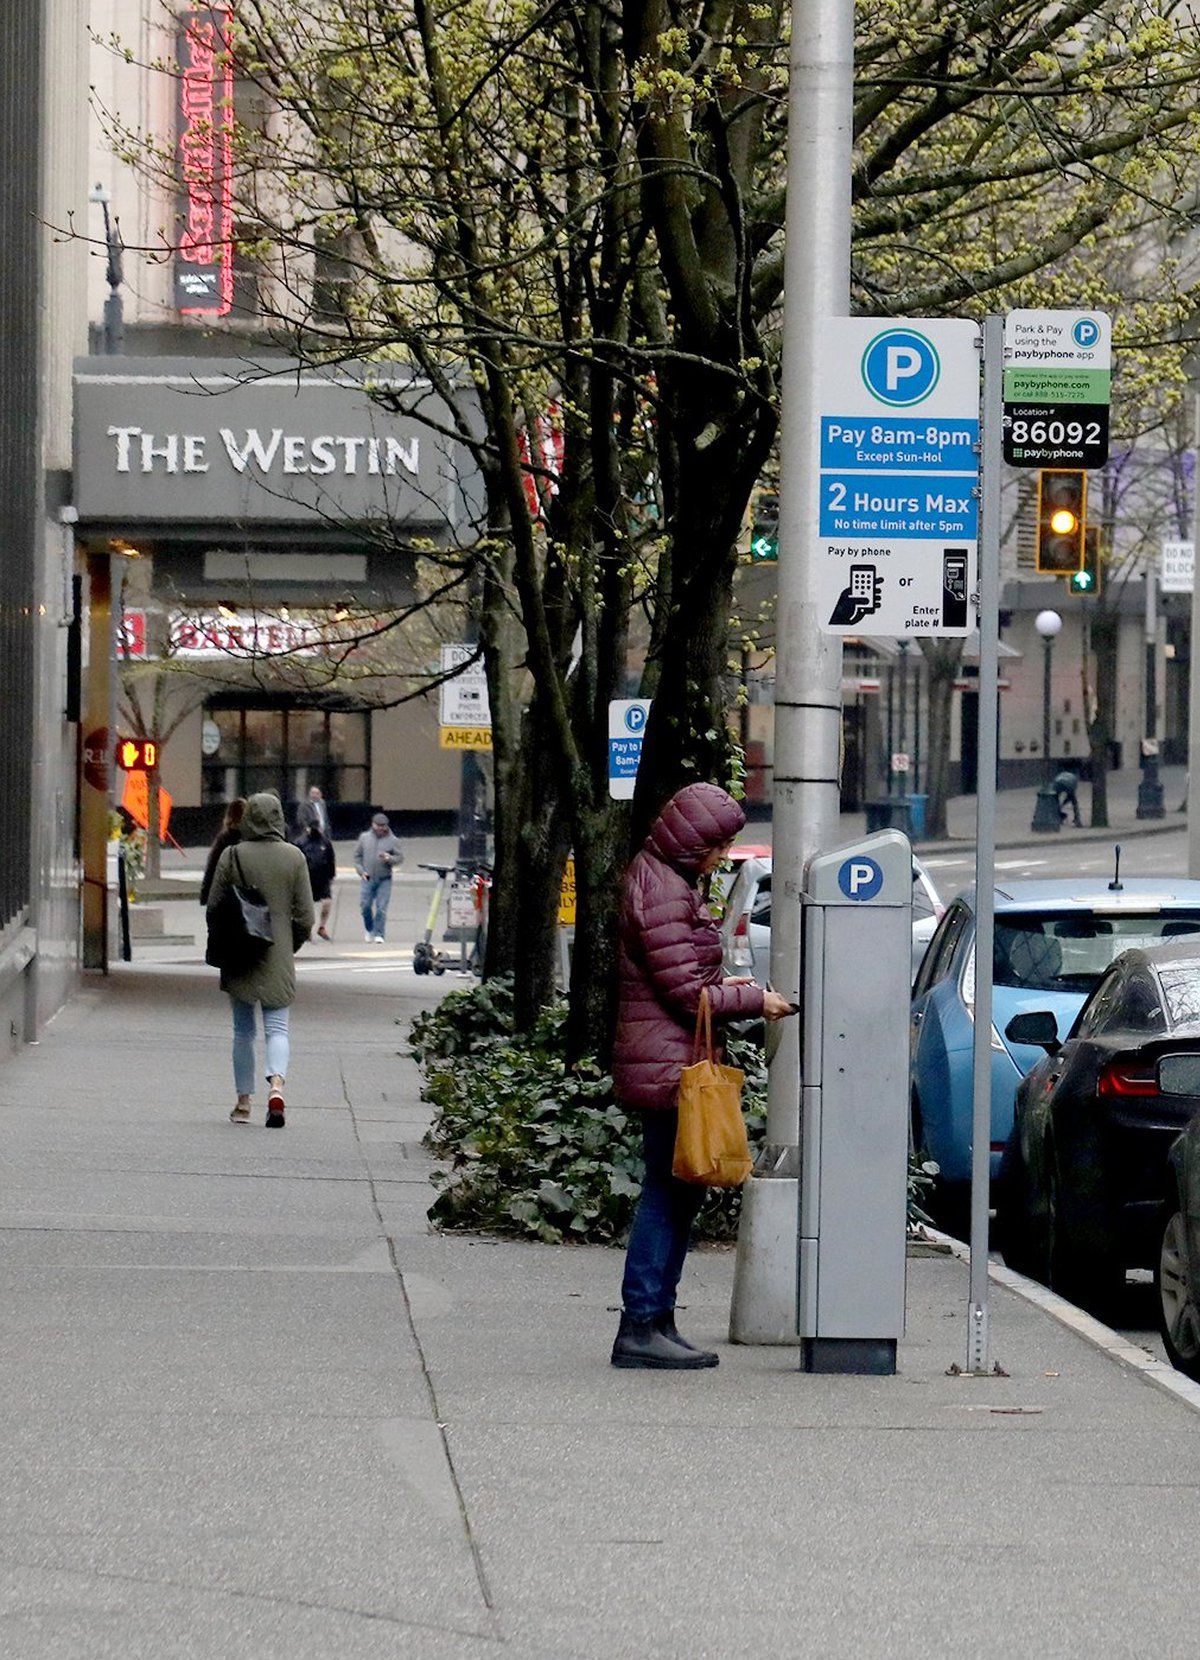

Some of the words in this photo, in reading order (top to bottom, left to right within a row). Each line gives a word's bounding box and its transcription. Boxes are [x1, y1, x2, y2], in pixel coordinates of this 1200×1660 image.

[1015, 324, 1035, 333] Park
[1037, 325, 1044, 333] &
[1046, 325, 1063, 336] Pay
[1080, 324, 1094, 341] P
[1015, 338, 1039, 347] using
[1042, 338, 1057, 346] the
[1015, 349, 1074, 360] paybyphone
[1076, 352, 1094, 360] app
[887, 346, 922, 390] P
[1014, 380, 1090, 389] paybyphone.com
[1013, 408, 1048, 416] Location
[828, 425, 865, 447] Pay
[871, 426, 971, 449] 8am-8pm
[1012, 421, 1100, 444] 86092
[107, 425, 209, 473] THE
[219, 427, 419, 475] WESTIN
[1024, 448, 1083, 458] paybyphone
[857, 451, 893, 463] Except
[896, 452, 942, 462] Sun-Hol
[828, 482, 847, 511] 2
[854, 493, 919, 512] Hours
[926, 494, 970, 513] Max
[835, 518, 849, 529] No
[852, 519, 878, 530] time
[880, 519, 906, 530] limit
[909, 520, 936, 531] after
[939, 520, 963, 532] 5pm
[828, 547, 845, 557] Pay
[848, 547, 859, 557] by
[862, 547, 891, 557] phone
[1181, 549, 1193, 558] NO
[899, 577, 914, 587] or
[913, 606, 940, 615] Enter
[905, 619, 929, 628] plate
[932, 619, 940, 627] #
[631, 710, 642, 728] P
[445, 731, 493, 746] AHEAD
[612, 742, 628, 754] Pay
[630, 742, 639, 752] to
[144, 743, 155, 766] 0
[850, 864, 875, 893] P
